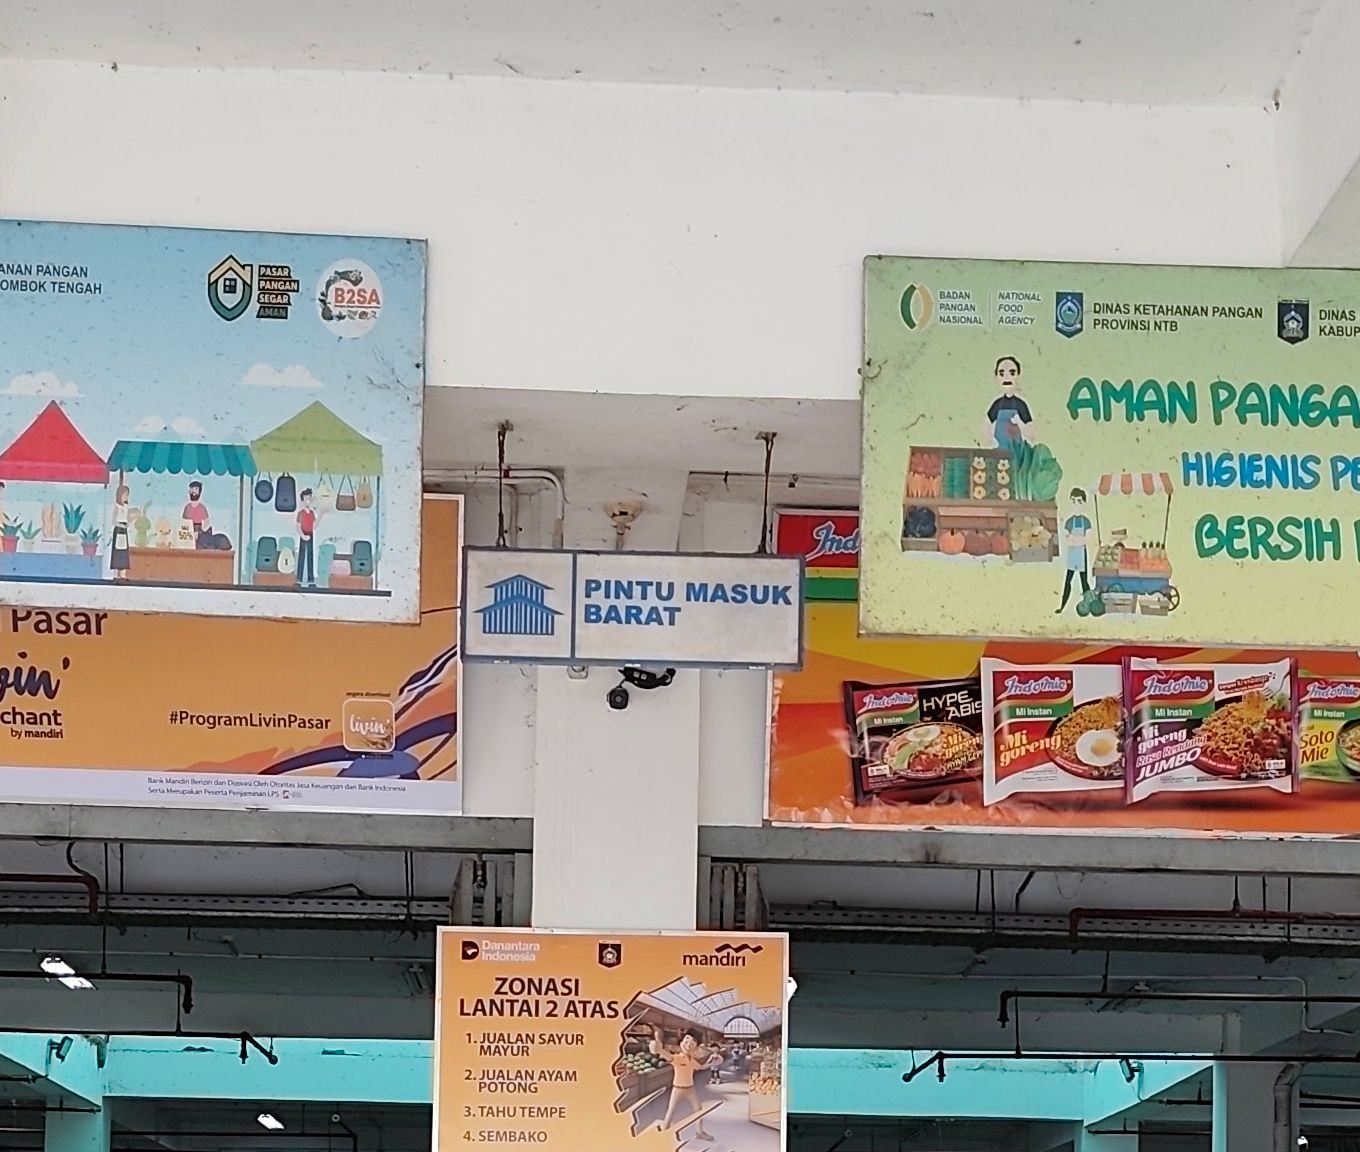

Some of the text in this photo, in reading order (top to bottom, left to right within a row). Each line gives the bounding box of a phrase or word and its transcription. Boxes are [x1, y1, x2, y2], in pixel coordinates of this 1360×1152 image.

[36, 264, 89, 278] PANGAN
[259, 266, 290, 277] PASAR
[49, 280, 102, 295] TENGAH
[259, 280, 298, 291] PANGAN
[258, 293, 289, 304] SEGAR
[334, 288, 381, 306] B2SA
[939, 291, 970, 300] BADAN
[998, 292, 1042, 302] NATIONAL
[258, 307, 287, 317] AMAN
[939, 303, 976, 312] PANGAN
[998, 305, 1023, 313] FOOD
[1093, 303, 1264, 319] DINAS KETAHANAN PANGAN
[939, 316, 983, 325] NASIONAL
[998, 316, 1035, 326] AGENCY
[1319, 309, 1356, 323] DINAS
[1093, 319, 1178, 332] PROVINSI NTB
[1067, 377, 1198, 425] AMAN
[1181, 451, 1321, 491] HIGIENIS
[1195, 513, 1340, 562] BERSIH
[585, 579, 792, 606] PINTU MASUK
[584, 603, 681, 626] BARAT
[12, 609, 108, 636] Pasar
[997, 676, 1067, 700] Indomie
[1135, 675, 1208, 700] Indomie
[1300, 682, 1360, 702] Indomie
[923, 690, 973, 712] HYPE
[945, 701, 982, 720] ABIS
[1016, 707, 1052, 716] Mi Instan
[1155, 708, 1192, 717] Mi Instan
[169, 710, 332, 732] #ProgramLivinPasar
[10, 727, 64, 741] by mandiri
[1000, 730, 1027, 751] Mi
[1137, 725, 1158, 741] Mi
[1299, 730, 1335, 749] Soto
[1138, 729, 1187, 754] goreng
[1000, 735, 1061, 766] goreng
[1301, 746, 1329, 765] Mie
[1136, 747, 1202, 781] JUMBO
[482, 940, 540, 952] Danantara
[482, 951, 536, 962] Indonesia
[683, 952, 746, 967] mandiri
[494, 977, 580, 997] ZONASI
[459, 998, 620, 1019] LANTAI 2 ATAS
[465, 1032, 585, 1046] 1. JUALAN SAYUR
[479, 1045, 530, 1057] MAYUR
[464, 1069, 578, 1082] 2. JUALAN AYAM
[478, 1081, 539, 1094] POTONG
[464, 1106, 567, 1119] 3. TAHU TEMPE
[463, 1130, 548, 1143] 4. SEMBAKO
